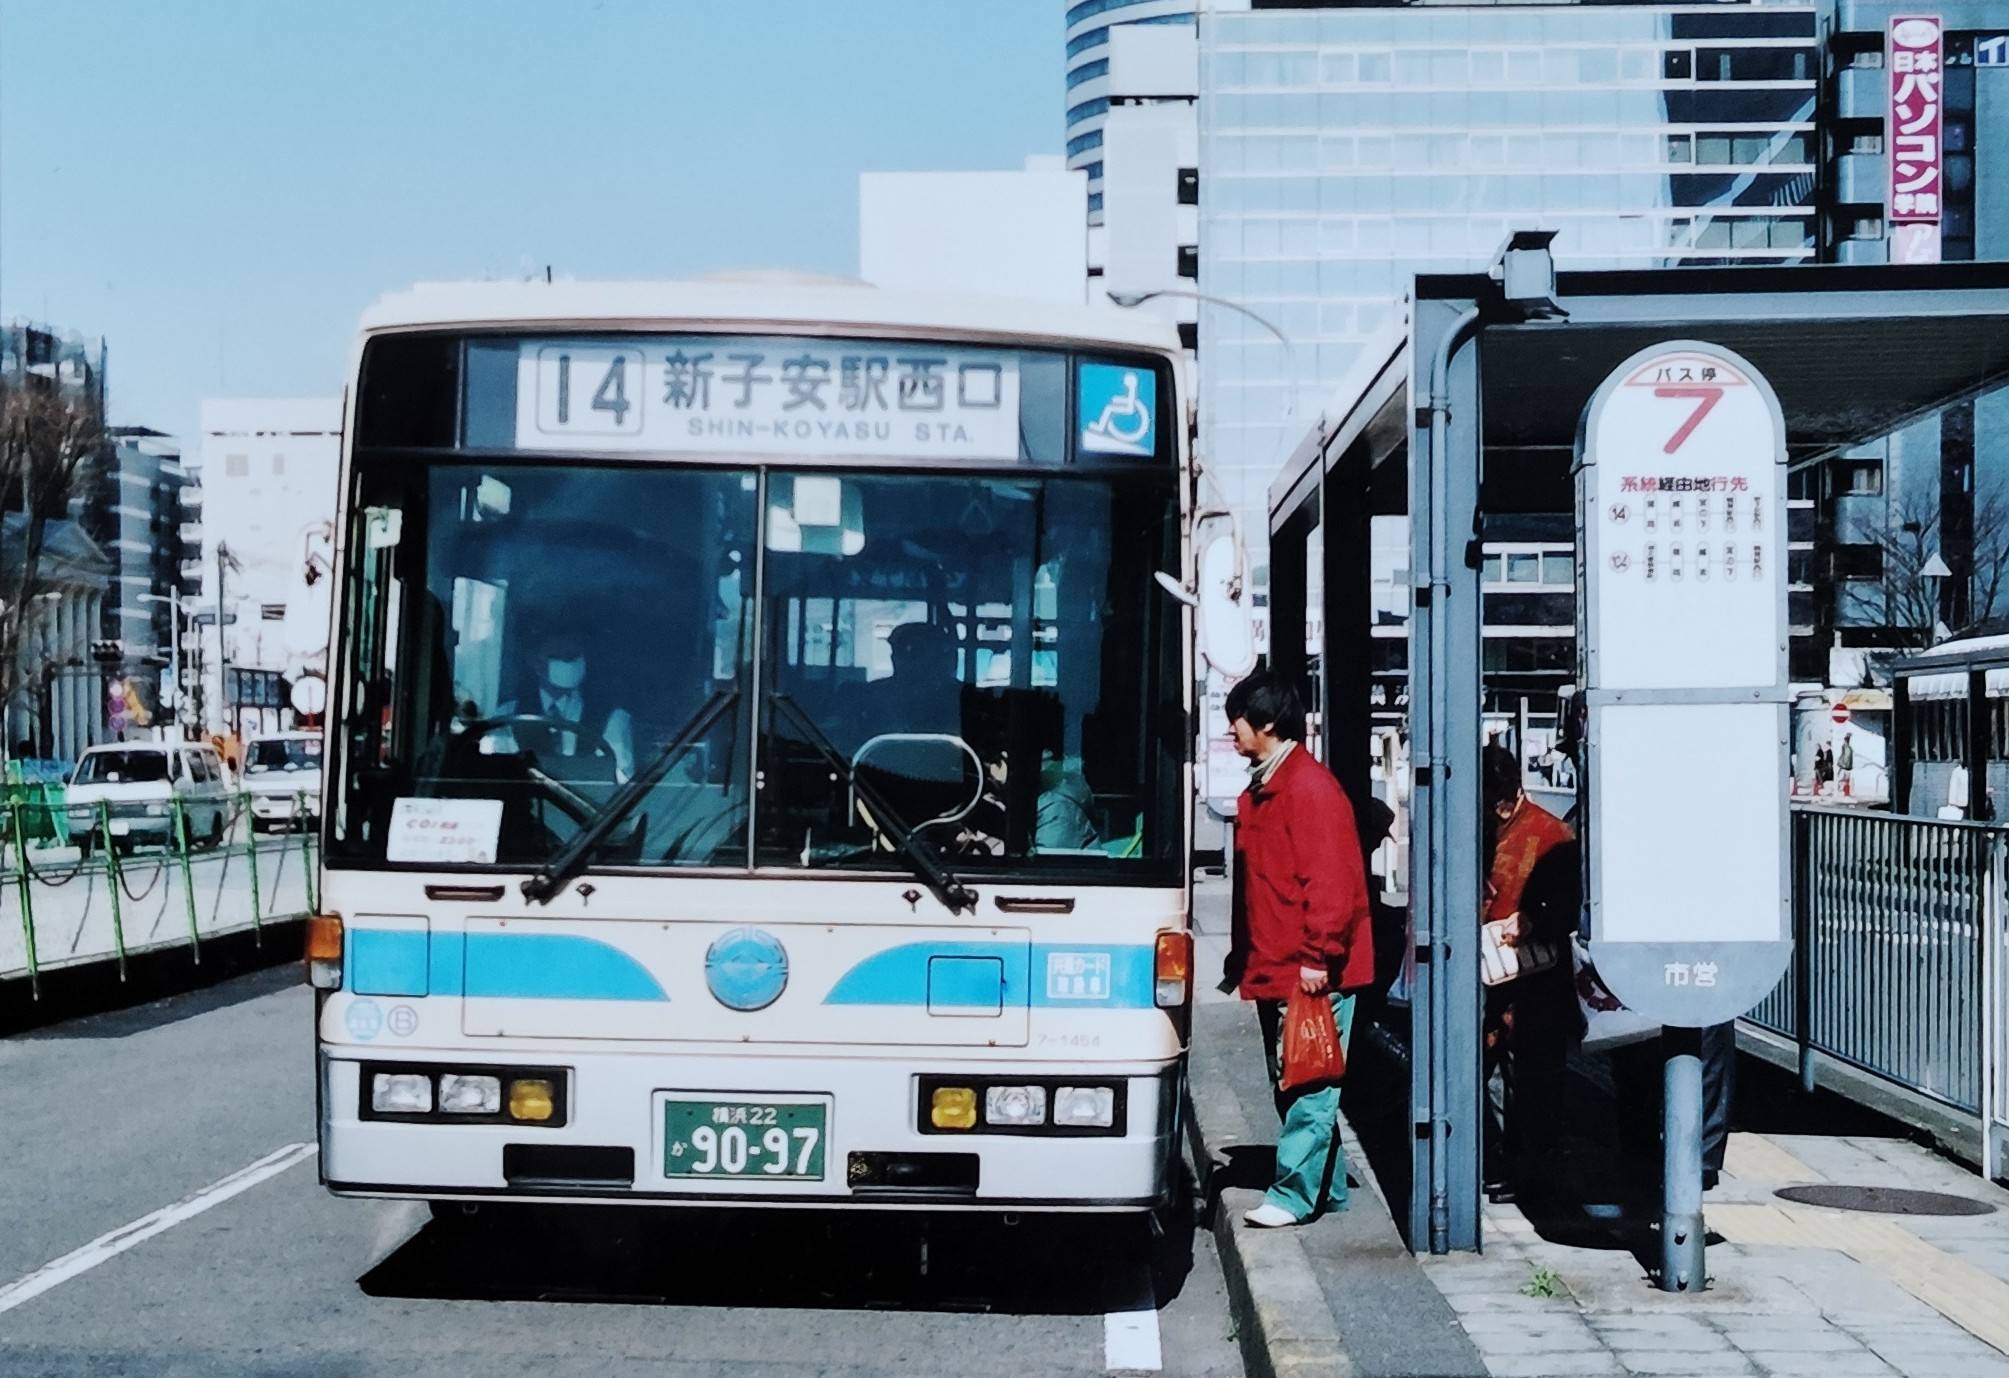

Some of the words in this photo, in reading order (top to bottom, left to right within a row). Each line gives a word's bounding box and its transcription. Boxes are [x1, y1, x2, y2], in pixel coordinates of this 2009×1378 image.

[1894, 51, 1938, 72] 日本
[1894, 73, 1939, 193] パソコン
[557, 354, 631, 425] 14
[663, 349, 1003, 411] 新子安駅西口
[1656, 367, 1717, 382] バス停
[688, 417, 891, 441] SHIN-KOYASU
[1654, 388, 1724, 454] 7
[1664, 961, 1719, 987] 市営
[691, 1126, 819, 1175] 90-97
